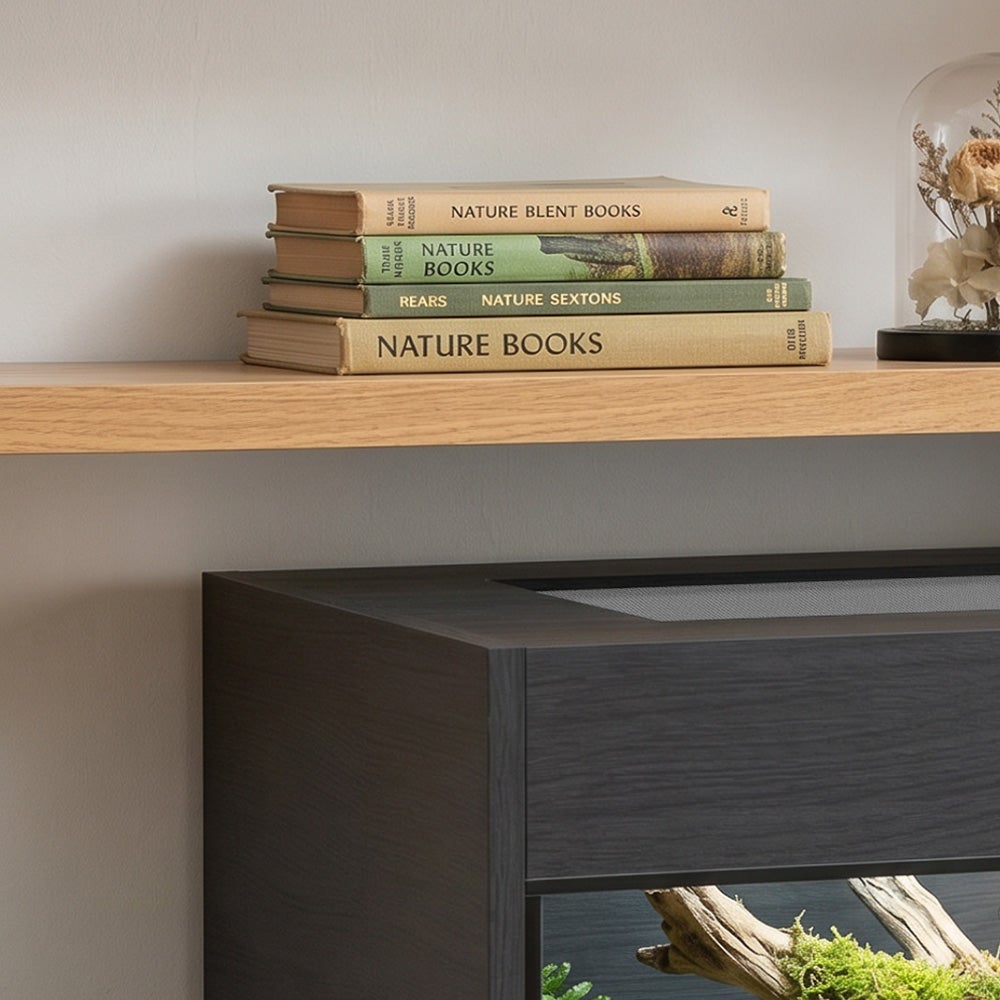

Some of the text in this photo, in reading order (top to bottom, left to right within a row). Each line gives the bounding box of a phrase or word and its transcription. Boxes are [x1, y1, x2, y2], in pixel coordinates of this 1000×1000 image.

[451, 203, 641, 219] NATURE BLENT BOOKS
[422, 243, 494, 257] NATURE
[424, 261, 495, 277] BOOKS
[399, 292, 622, 308] REARS NATURE SEXTONS
[378, 332, 603, 358] NATURE BOOKS
